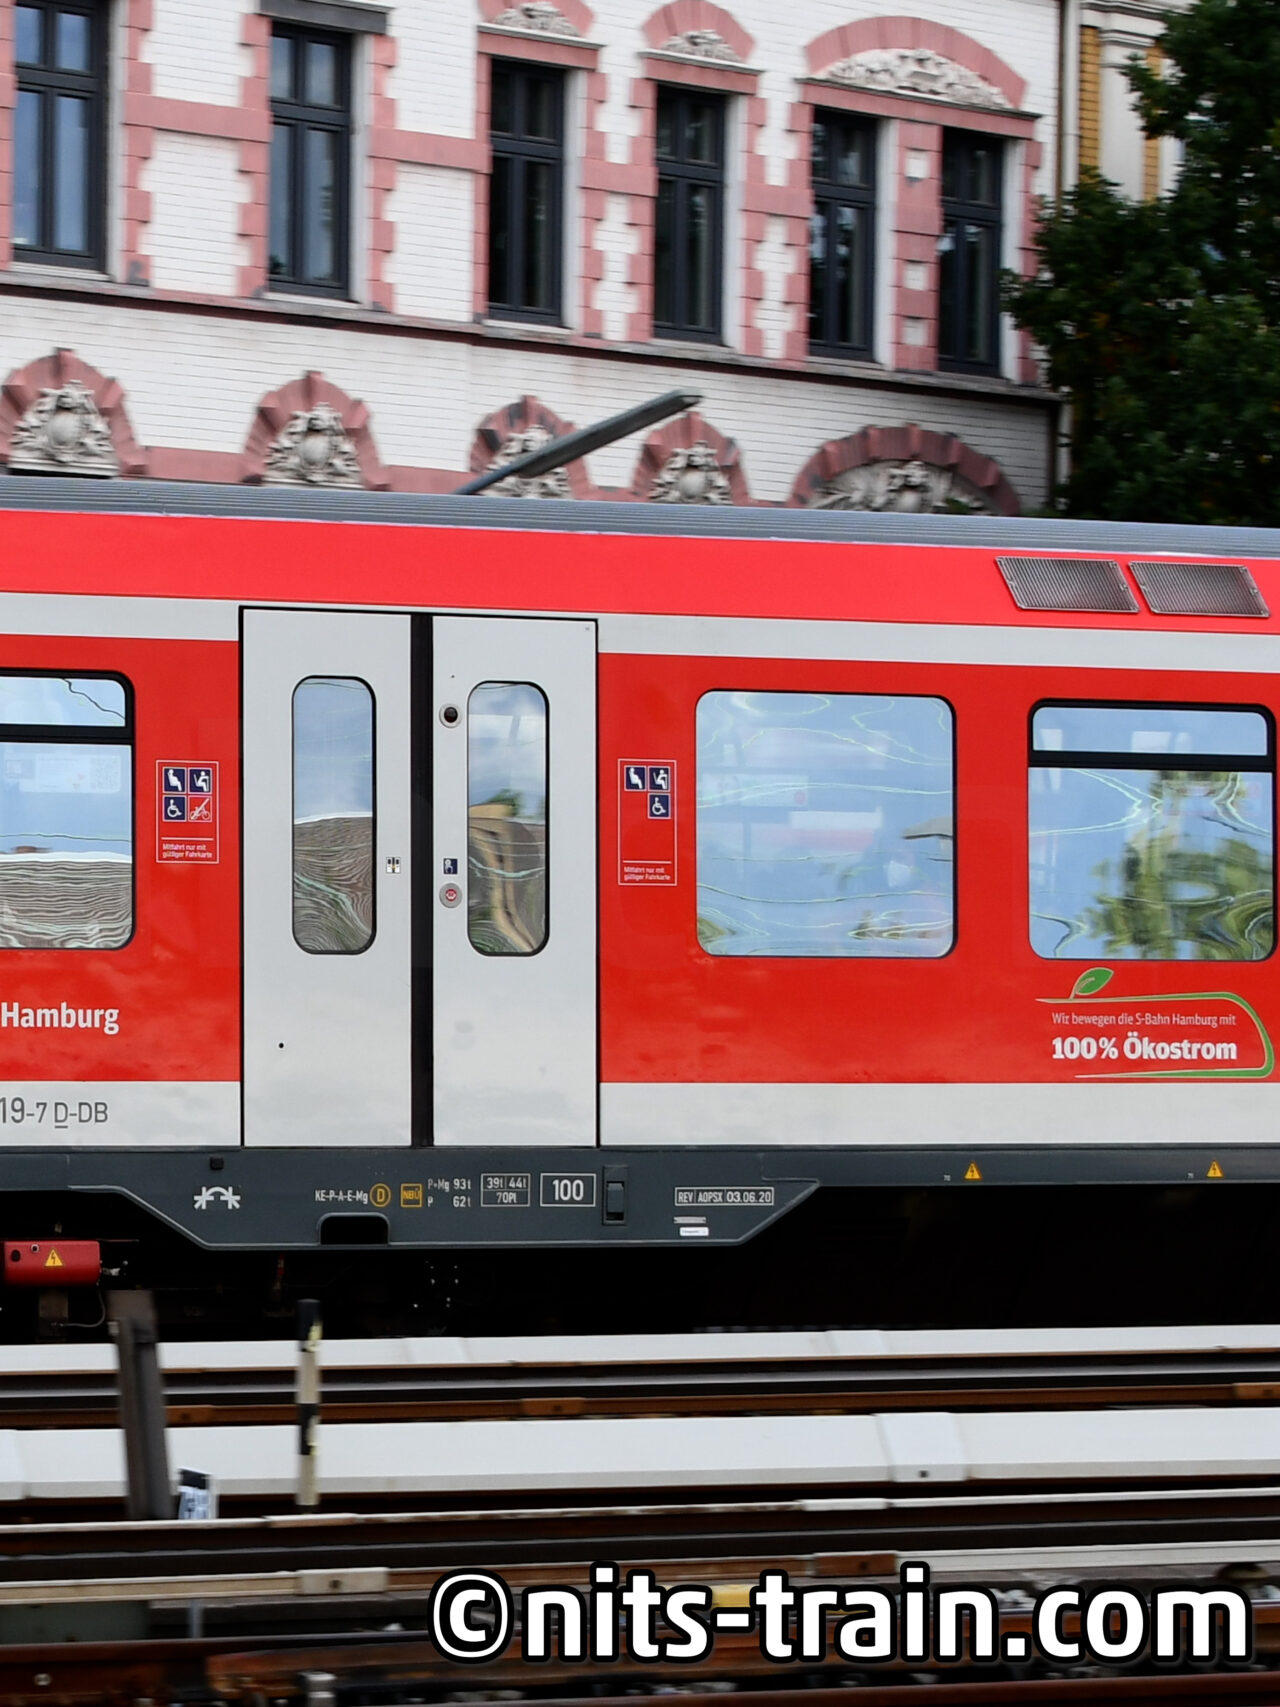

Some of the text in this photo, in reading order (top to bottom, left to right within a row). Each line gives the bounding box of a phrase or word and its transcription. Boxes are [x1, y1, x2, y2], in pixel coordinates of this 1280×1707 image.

[1, 1002, 120, 1034] Hamburg
[1052, 1012, 1236, 1028] Wir bewegen die S-Bahn Hamburg mit
[1052, 1031, 1237, 1060] 100% Ökostrom
[54, 1101, 108, 1129] D-DB
[427, 1195, 434, 1207] P
[552, 1179, 584, 1201] 100
[678, 1191, 694, 1203] REV
[726, 1191, 772, 1203] 03.06.20
